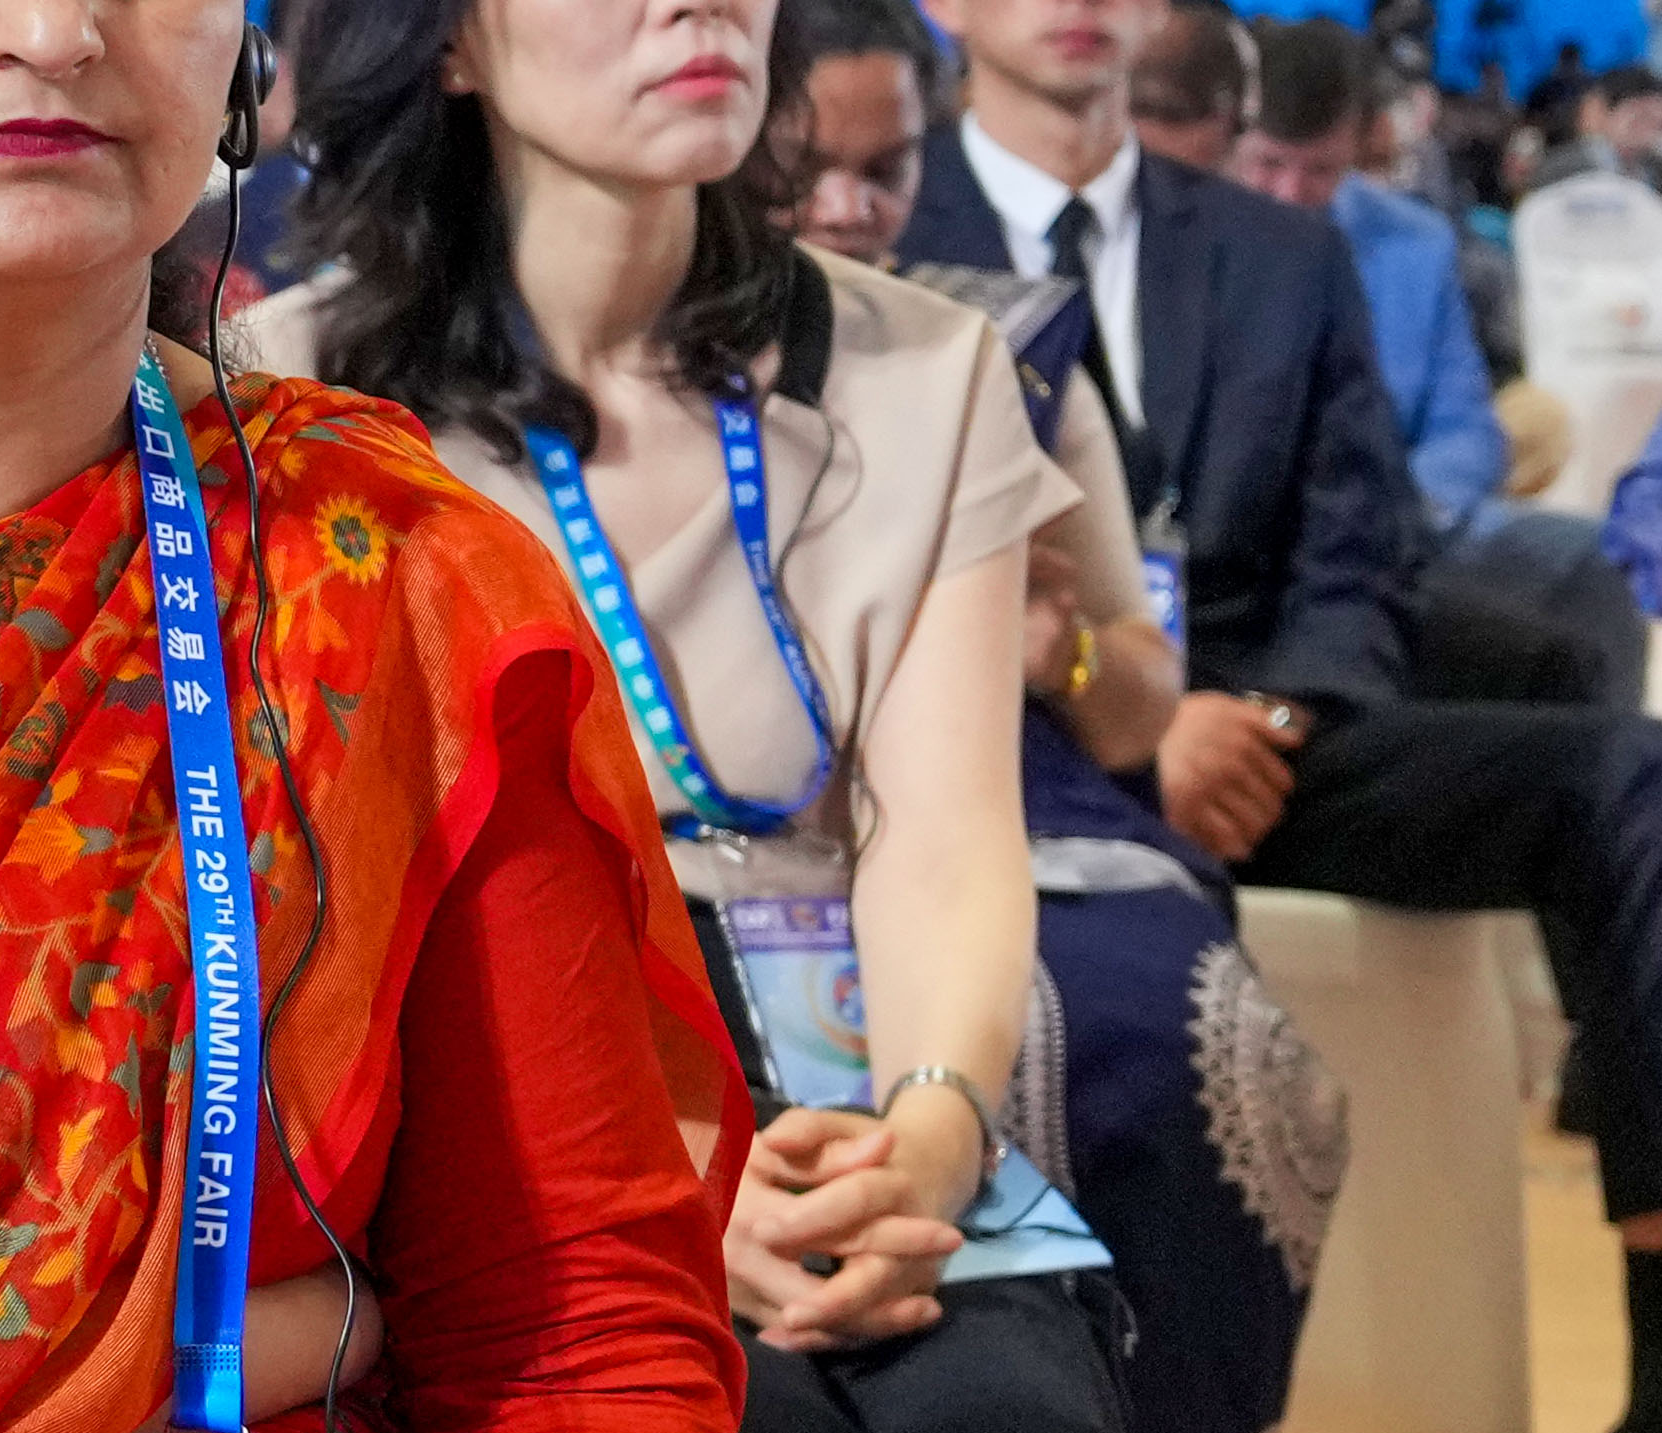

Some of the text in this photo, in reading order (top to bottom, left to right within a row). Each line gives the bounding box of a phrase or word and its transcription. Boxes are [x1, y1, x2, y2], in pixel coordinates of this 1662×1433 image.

[134, 353, 245, 1249] 出口商品交易会 THE 29TH KUNMING FAIR
